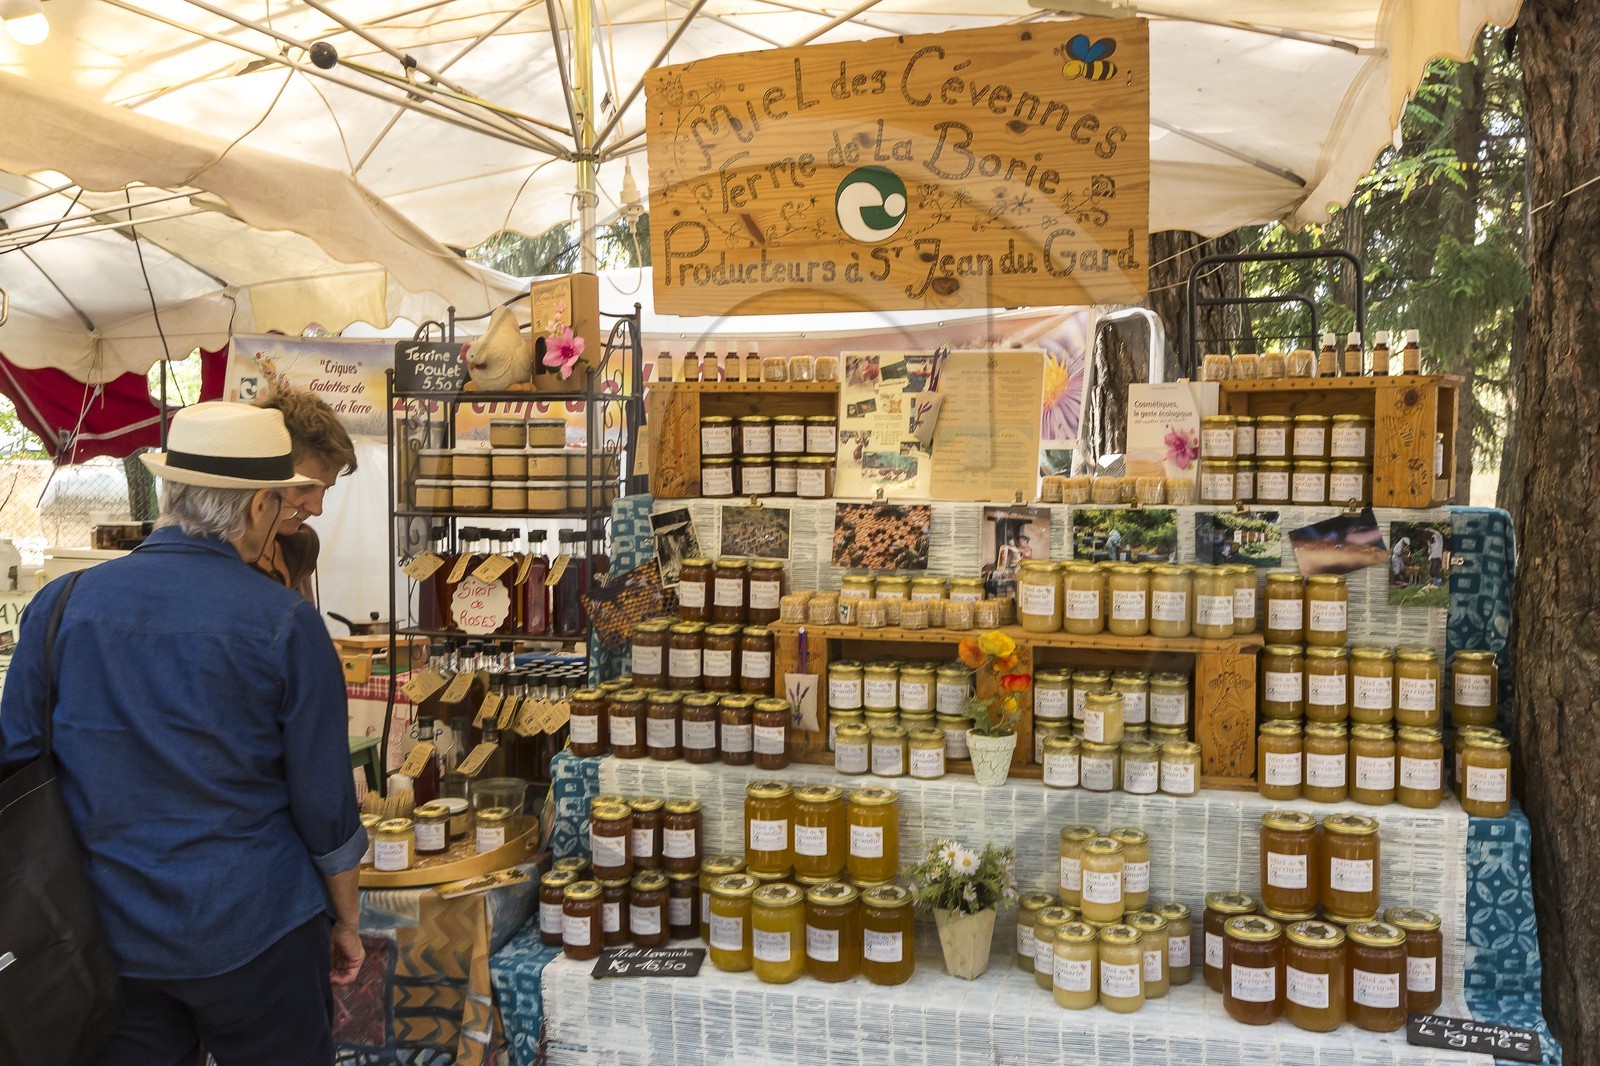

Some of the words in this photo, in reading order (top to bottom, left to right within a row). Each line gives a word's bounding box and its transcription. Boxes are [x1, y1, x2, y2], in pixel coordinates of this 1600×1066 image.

[831, 60, 887, 100] des
[900, 46, 1127, 160] Cévennes
[719, 150, 815, 214] Ferme
[828, 131, 857, 169] de
[876, 119, 913, 162] La
[923, 121, 1061, 195] Borie
[664, 221, 836, 286] Producteurs
[845, 252, 864, 283] à
[905, 238, 995, 299] Jean
[1000, 239, 1038, 276] du
[1043, 228, 1140, 278] Gard
[405, 346, 450, 361] Terrine
[415, 363, 461, 378] Poulet
[309, 379, 349, 393] Galettes
[350, 381, 366, 394] de
[422, 376, 452, 391] 5,50
[335, 400, 348, 413] de
[347, 400, 372, 415] Terre
[470, 600, 485, 609] de
[608, 959, 631, 973] Kg
[1443, 1029, 1467, 1048] Kg
[1483, 1036, 1511, 1049] 16
[1514, 1042, 1530, 1052] €
